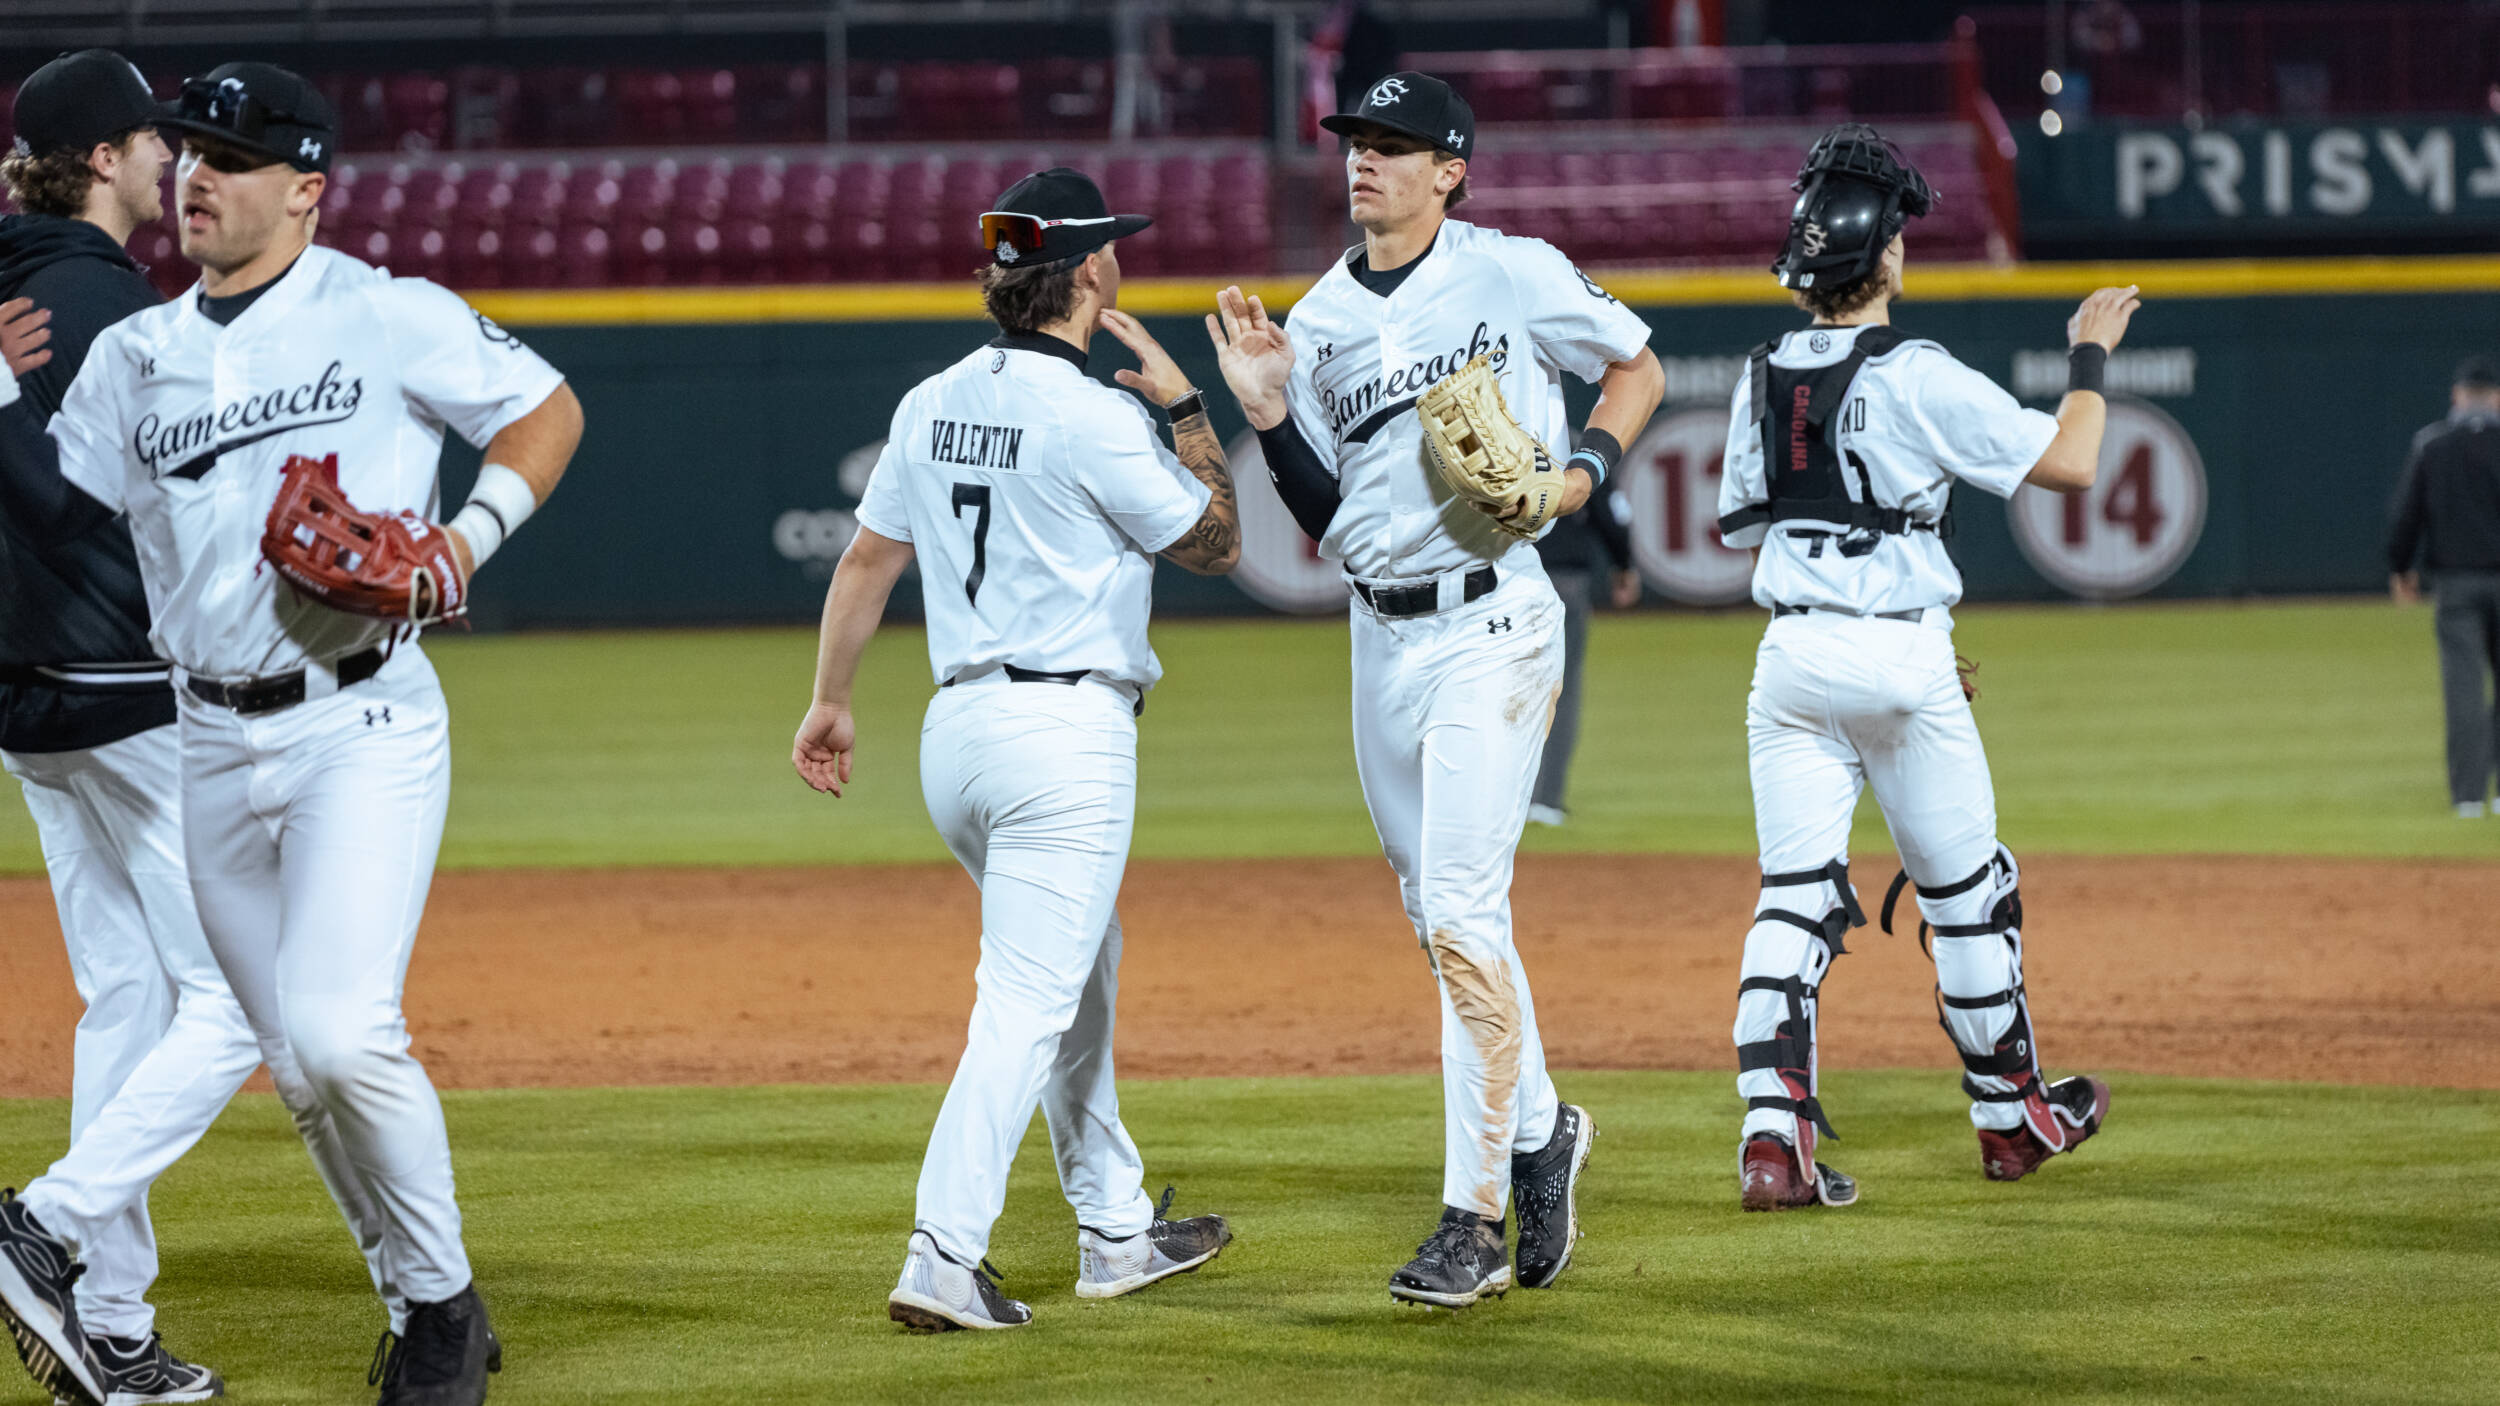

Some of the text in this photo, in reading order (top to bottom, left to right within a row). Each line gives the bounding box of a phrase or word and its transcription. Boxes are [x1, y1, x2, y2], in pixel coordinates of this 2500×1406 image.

[134, 360, 363, 481] Gamecocks
[932, 420, 1024, 469] VALENTIN
[1791, 385, 1811, 471] CAROLINA
[952, 482, 991, 609] 7
